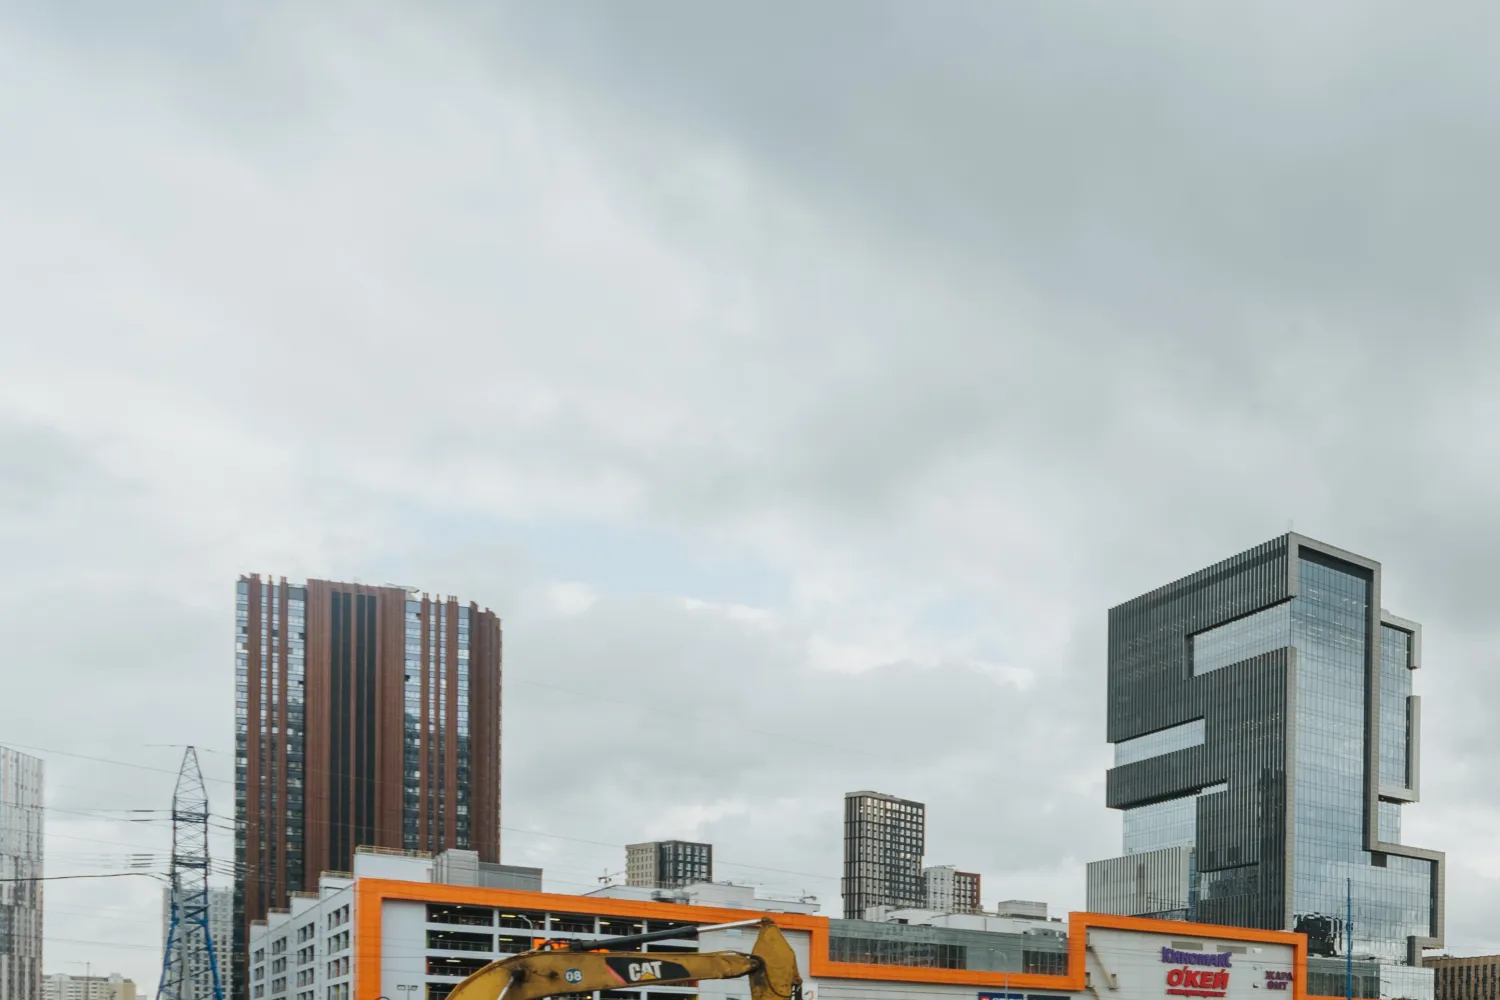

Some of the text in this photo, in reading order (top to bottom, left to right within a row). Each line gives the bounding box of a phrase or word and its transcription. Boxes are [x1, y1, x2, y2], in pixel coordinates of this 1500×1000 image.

[1161, 946, 1233, 968] КИНОМАКС
[565, 970, 582, 982] 08
[628, 961, 663, 981] CAT
[1265, 970, 1293, 981] ЖАРА
